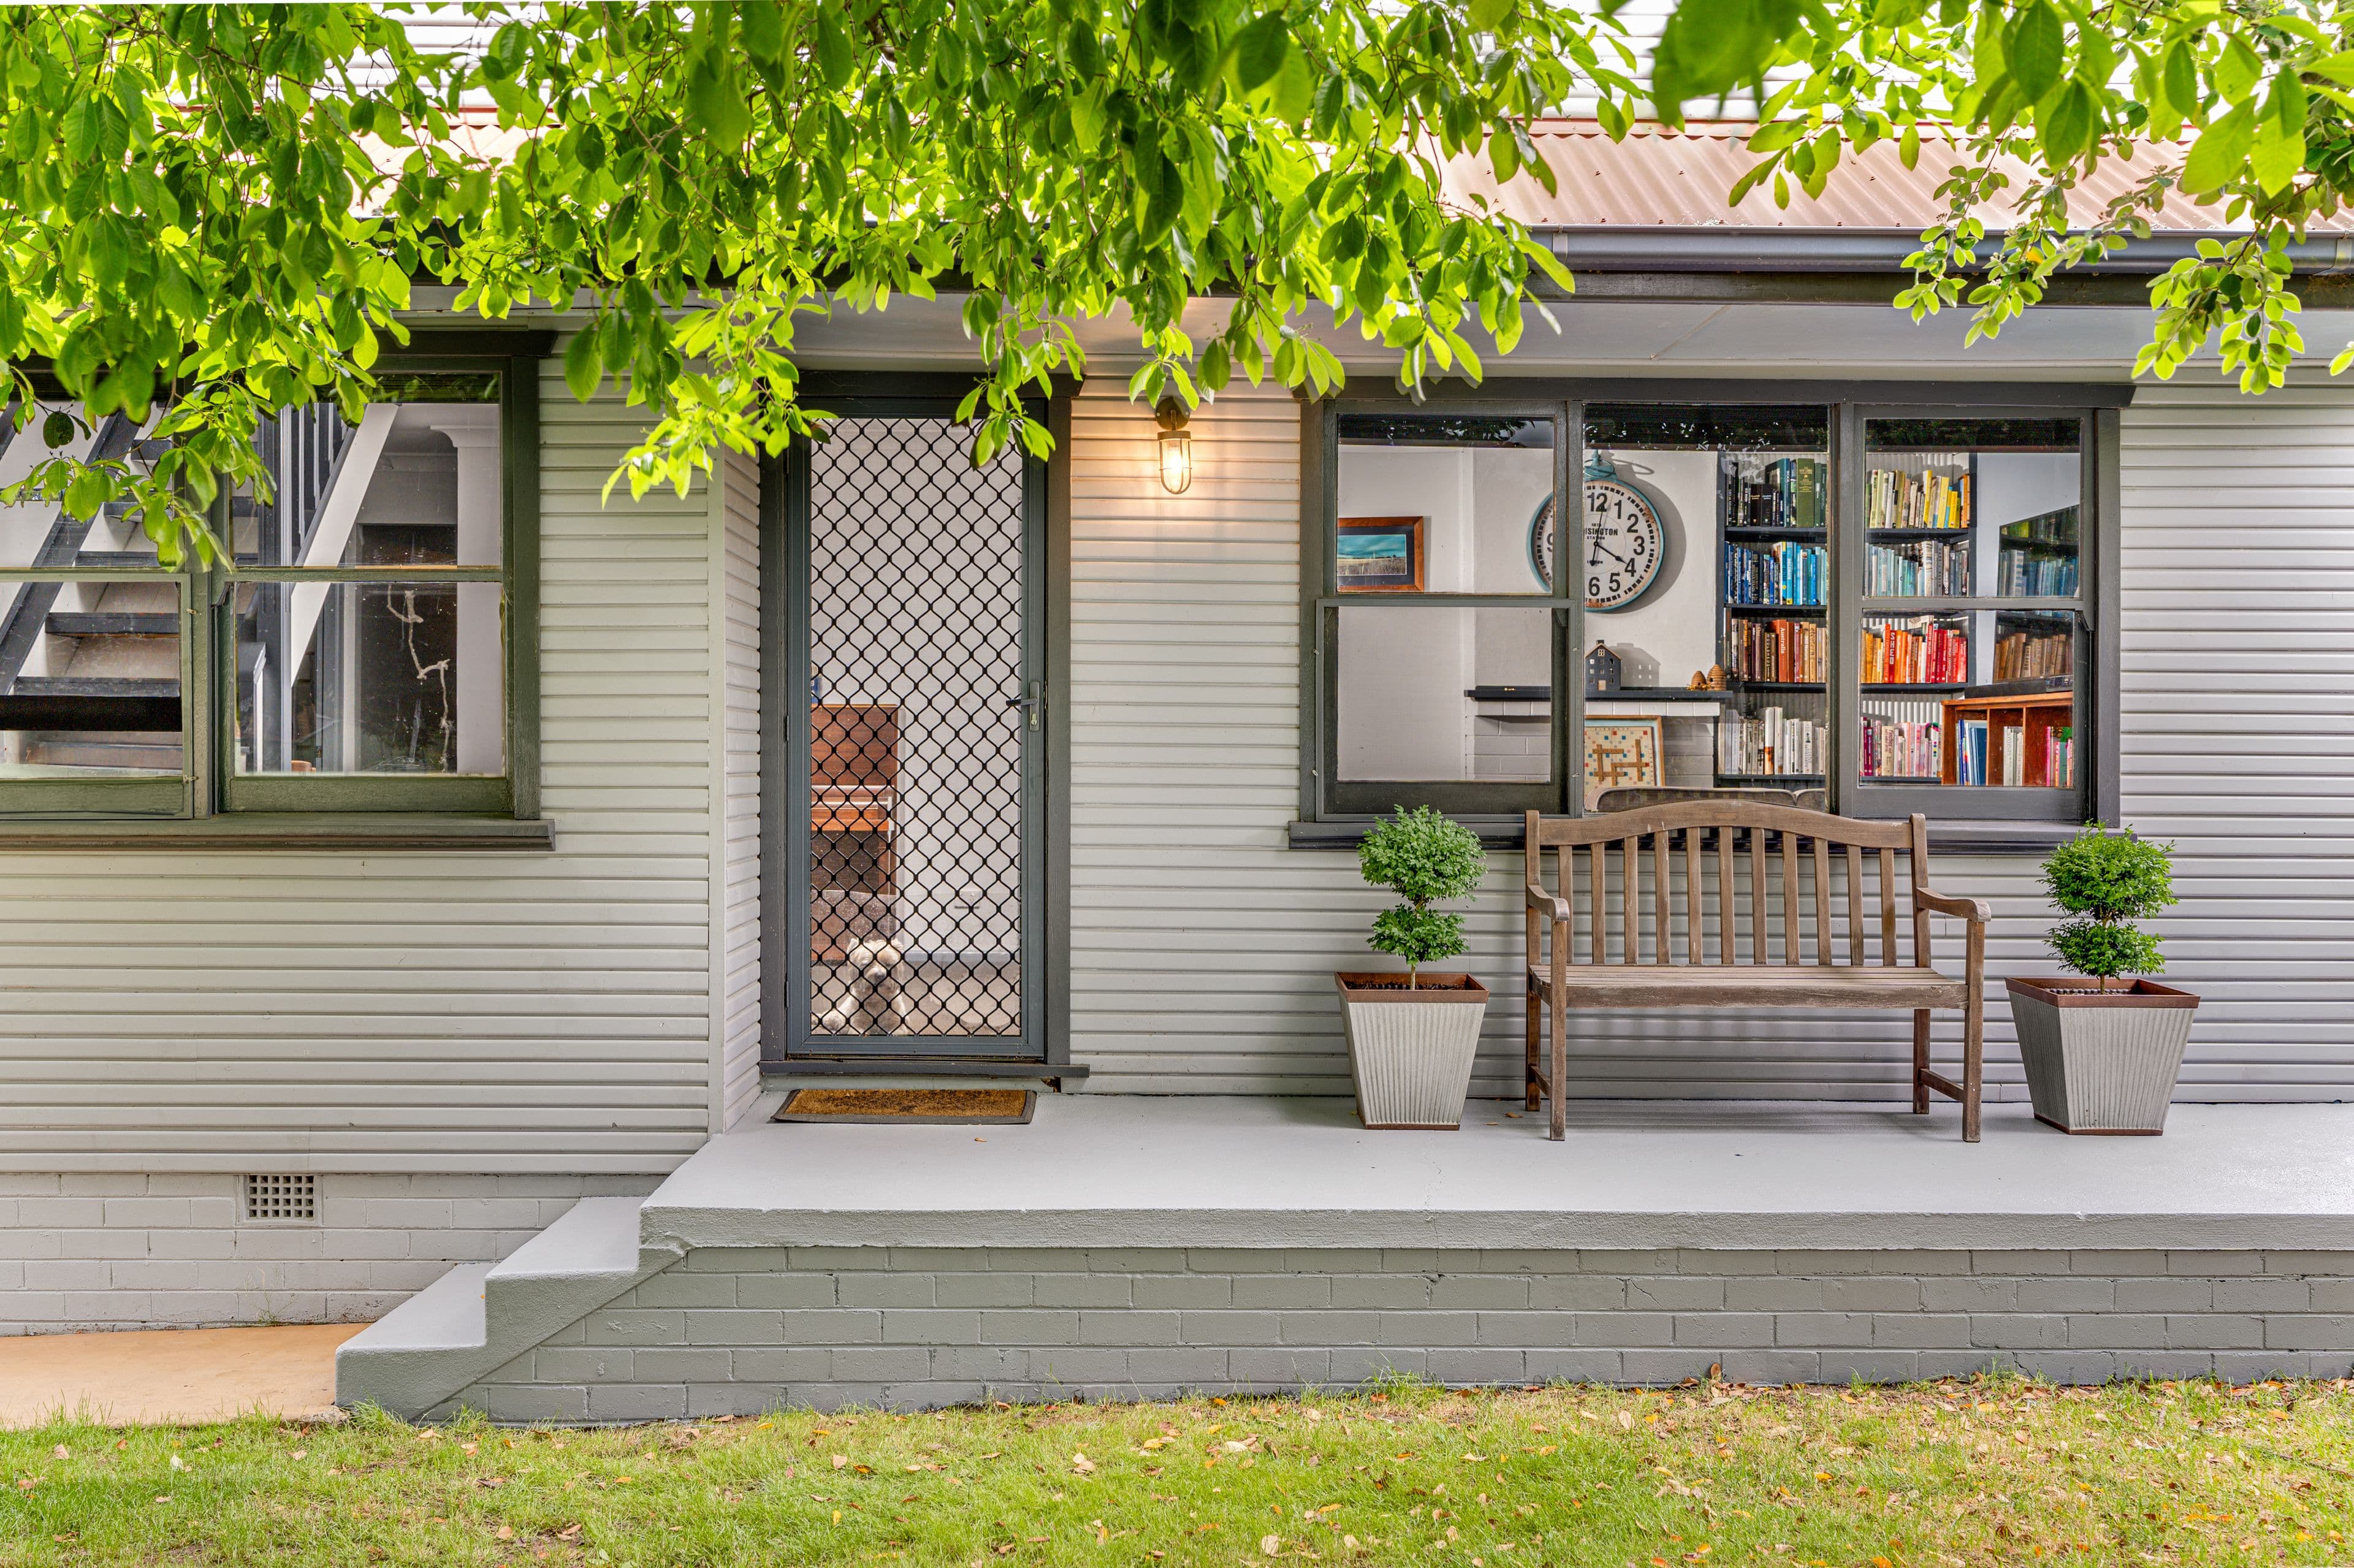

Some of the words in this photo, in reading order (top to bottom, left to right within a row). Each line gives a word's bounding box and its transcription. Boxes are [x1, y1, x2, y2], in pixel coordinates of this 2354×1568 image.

[1587, 492, 1607, 512] 12
[1614, 500, 1622, 519] 1
[1626, 514, 1639, 533] 2
[1633, 536, 1645, 555] 3
[1625, 558, 1637, 577] 4
[1588, 576, 1600, 596] 6
[1609, 572, 1621, 592] 5
